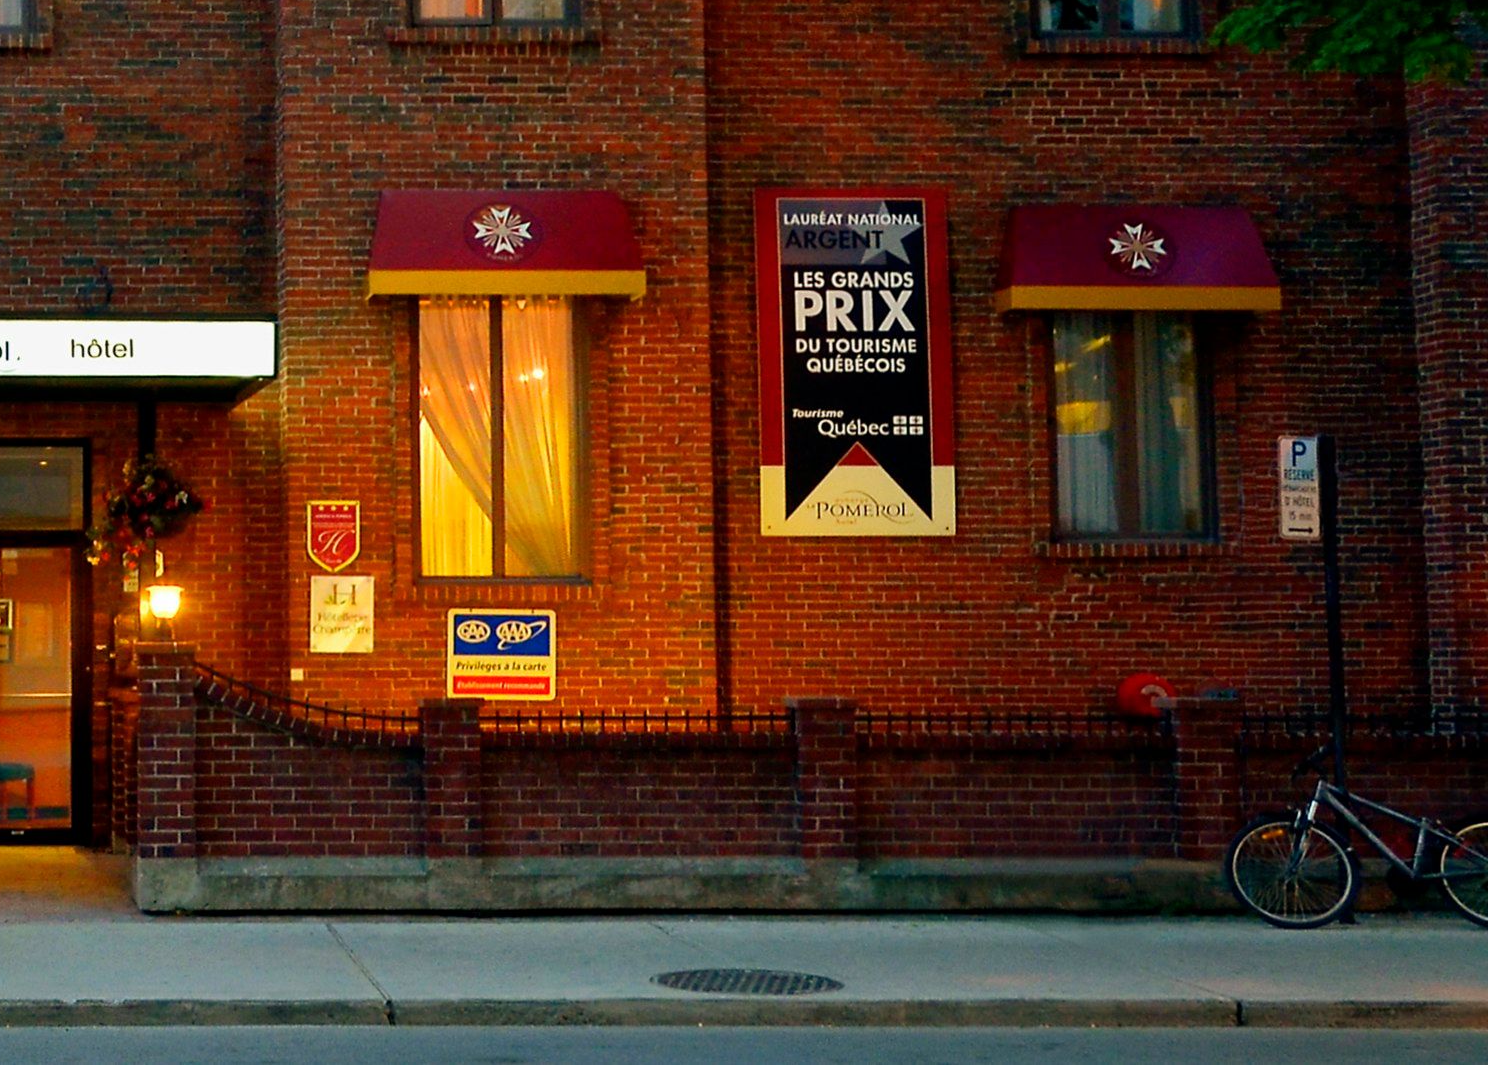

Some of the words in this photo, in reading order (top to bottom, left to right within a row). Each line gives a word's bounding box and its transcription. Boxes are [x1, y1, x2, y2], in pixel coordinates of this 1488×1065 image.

[784, 210, 842, 226] LAURÉAT
[847, 213, 920, 226] NATIONAL
[785, 230, 883, 249] ARGENT
[793, 271, 825, 288] LES
[831, 271, 914, 288] GRANDS
[794, 289, 916, 332] PRIX
[70, 337, 135, 360] hôtel
[795, 338, 821, 353] DU
[826, 338, 917, 353] TOURISME
[806, 353, 906, 373] QUÉBÉCOIS
[792, 408, 844, 419] Tourisme
[818, 418, 890, 438] Québec
[1292, 441, 1307, 467] P
[816, 498, 915, 521] POMEROL
[499, 622, 529, 641] AAA
[523, 662, 547, 672] carte
